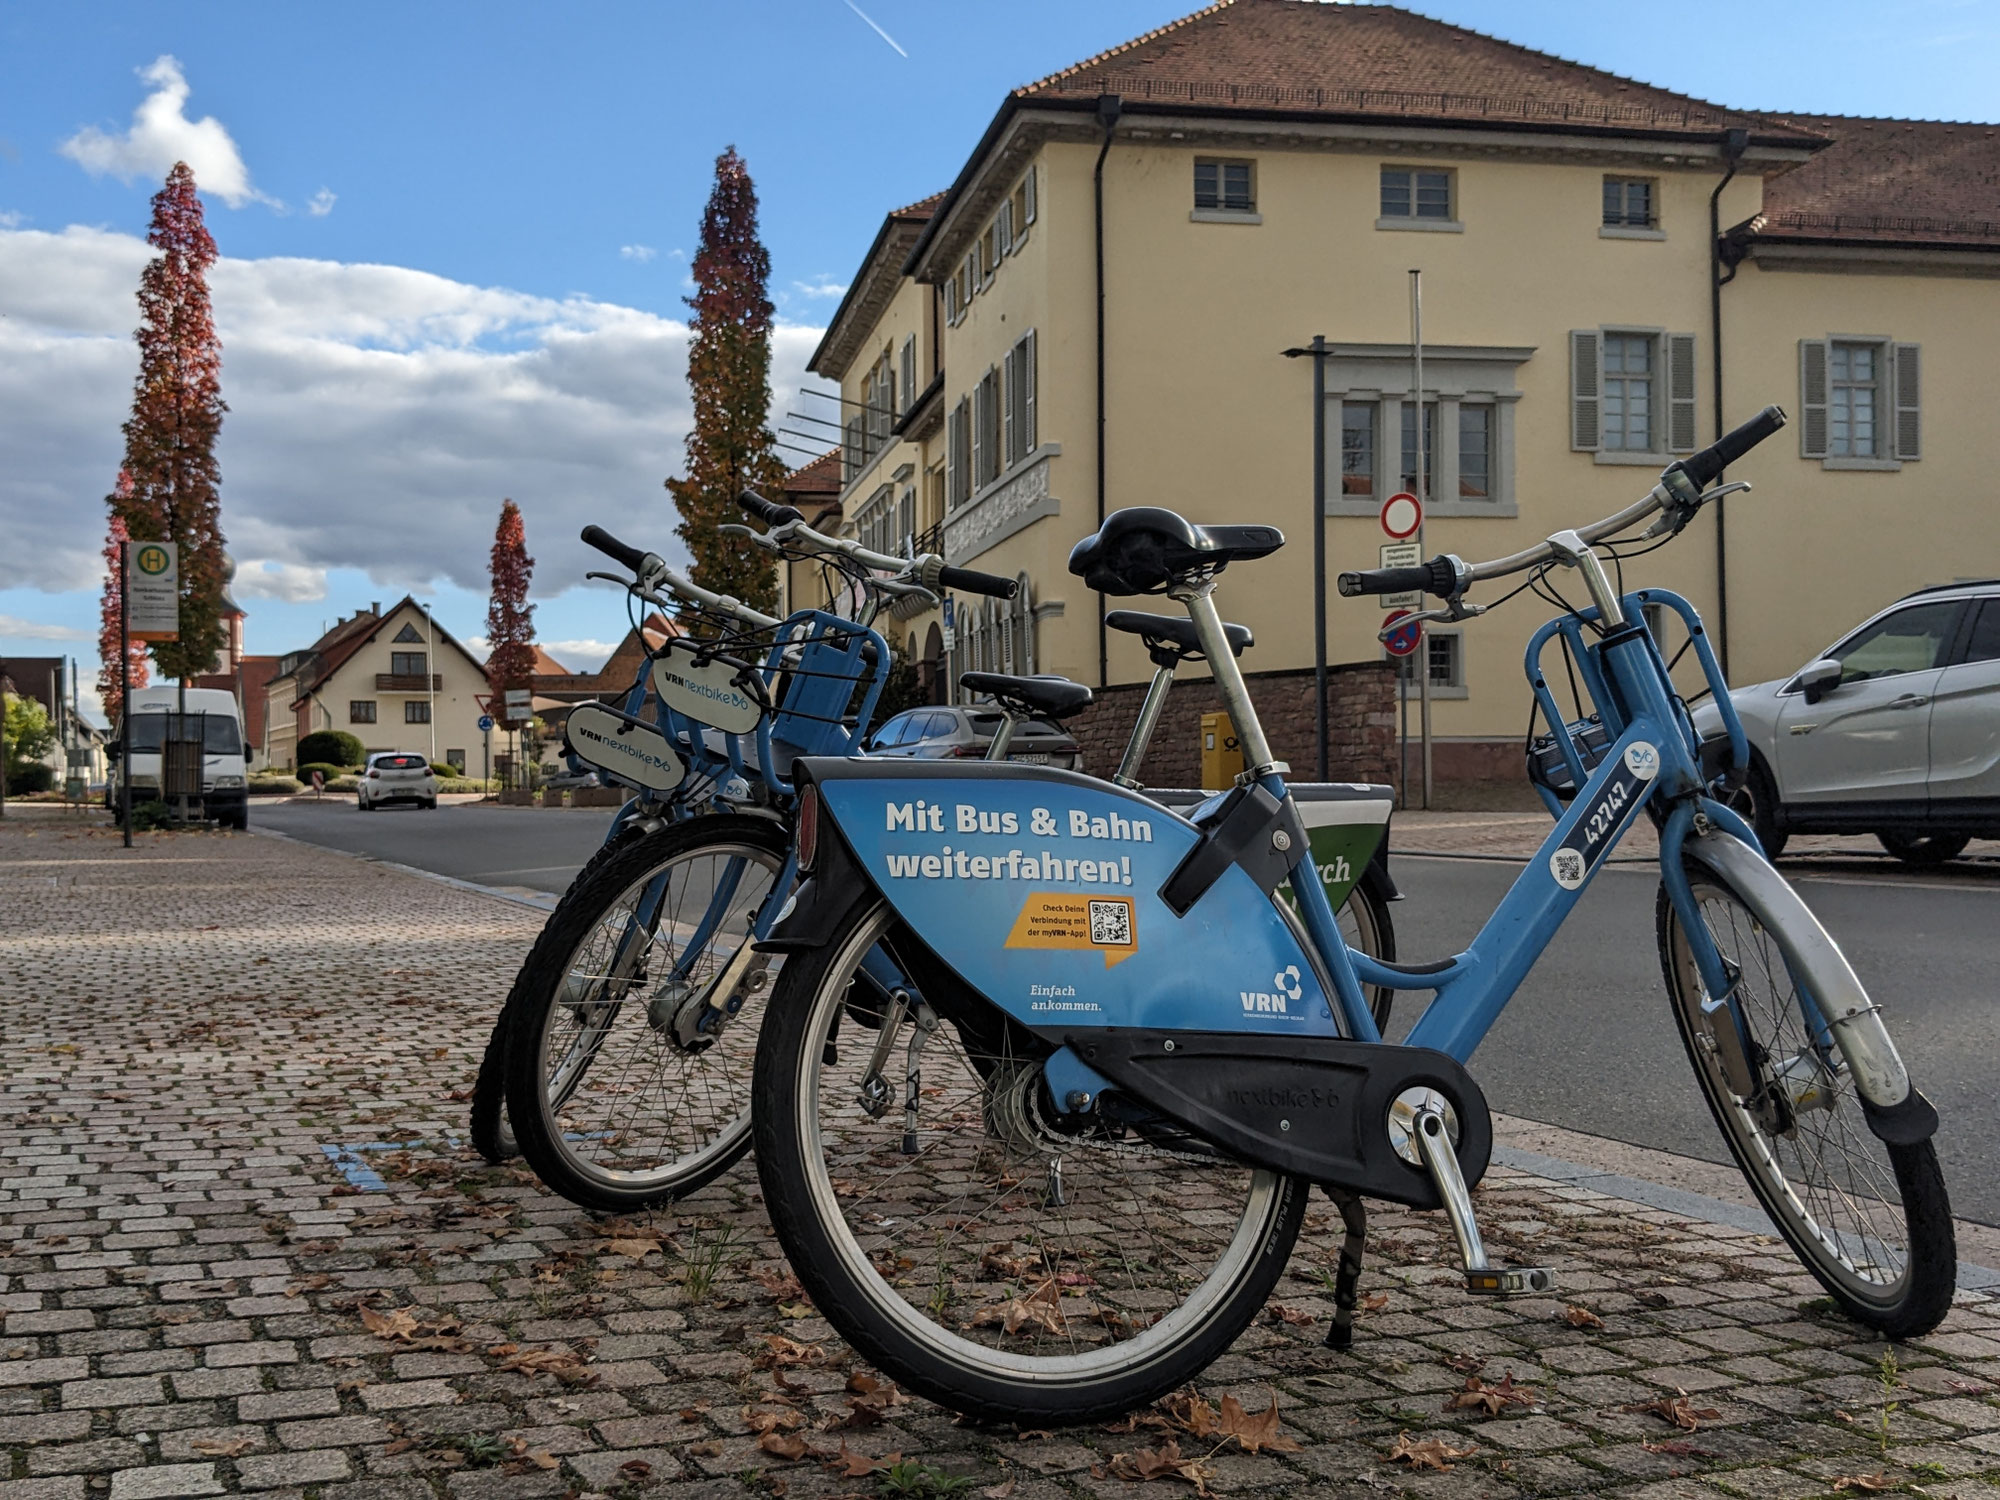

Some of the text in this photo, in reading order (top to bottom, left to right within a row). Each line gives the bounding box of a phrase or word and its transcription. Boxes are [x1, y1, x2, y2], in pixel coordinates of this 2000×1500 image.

[146, 551, 160, 569] H
[665, 671, 730, 704] VRN nextbike
[580, 727, 653, 764] VRN nextbike
[886, 800, 1153, 842] Mit Bus & Bahn
[1584, 781, 1628, 845] 42747
[886, 846, 1133, 885] weiterfahren!
[1042, 904, 1085, 913] Check Deine
[1030, 916, 1086, 926] Verbindung mit
[1042, 929, 1087, 938] myVRN-App!
[1030, 984, 1076, 998] Einfach
[1031, 1000, 1102, 1012] ankommen.
[1240, 992, 1286, 1012] VRN
